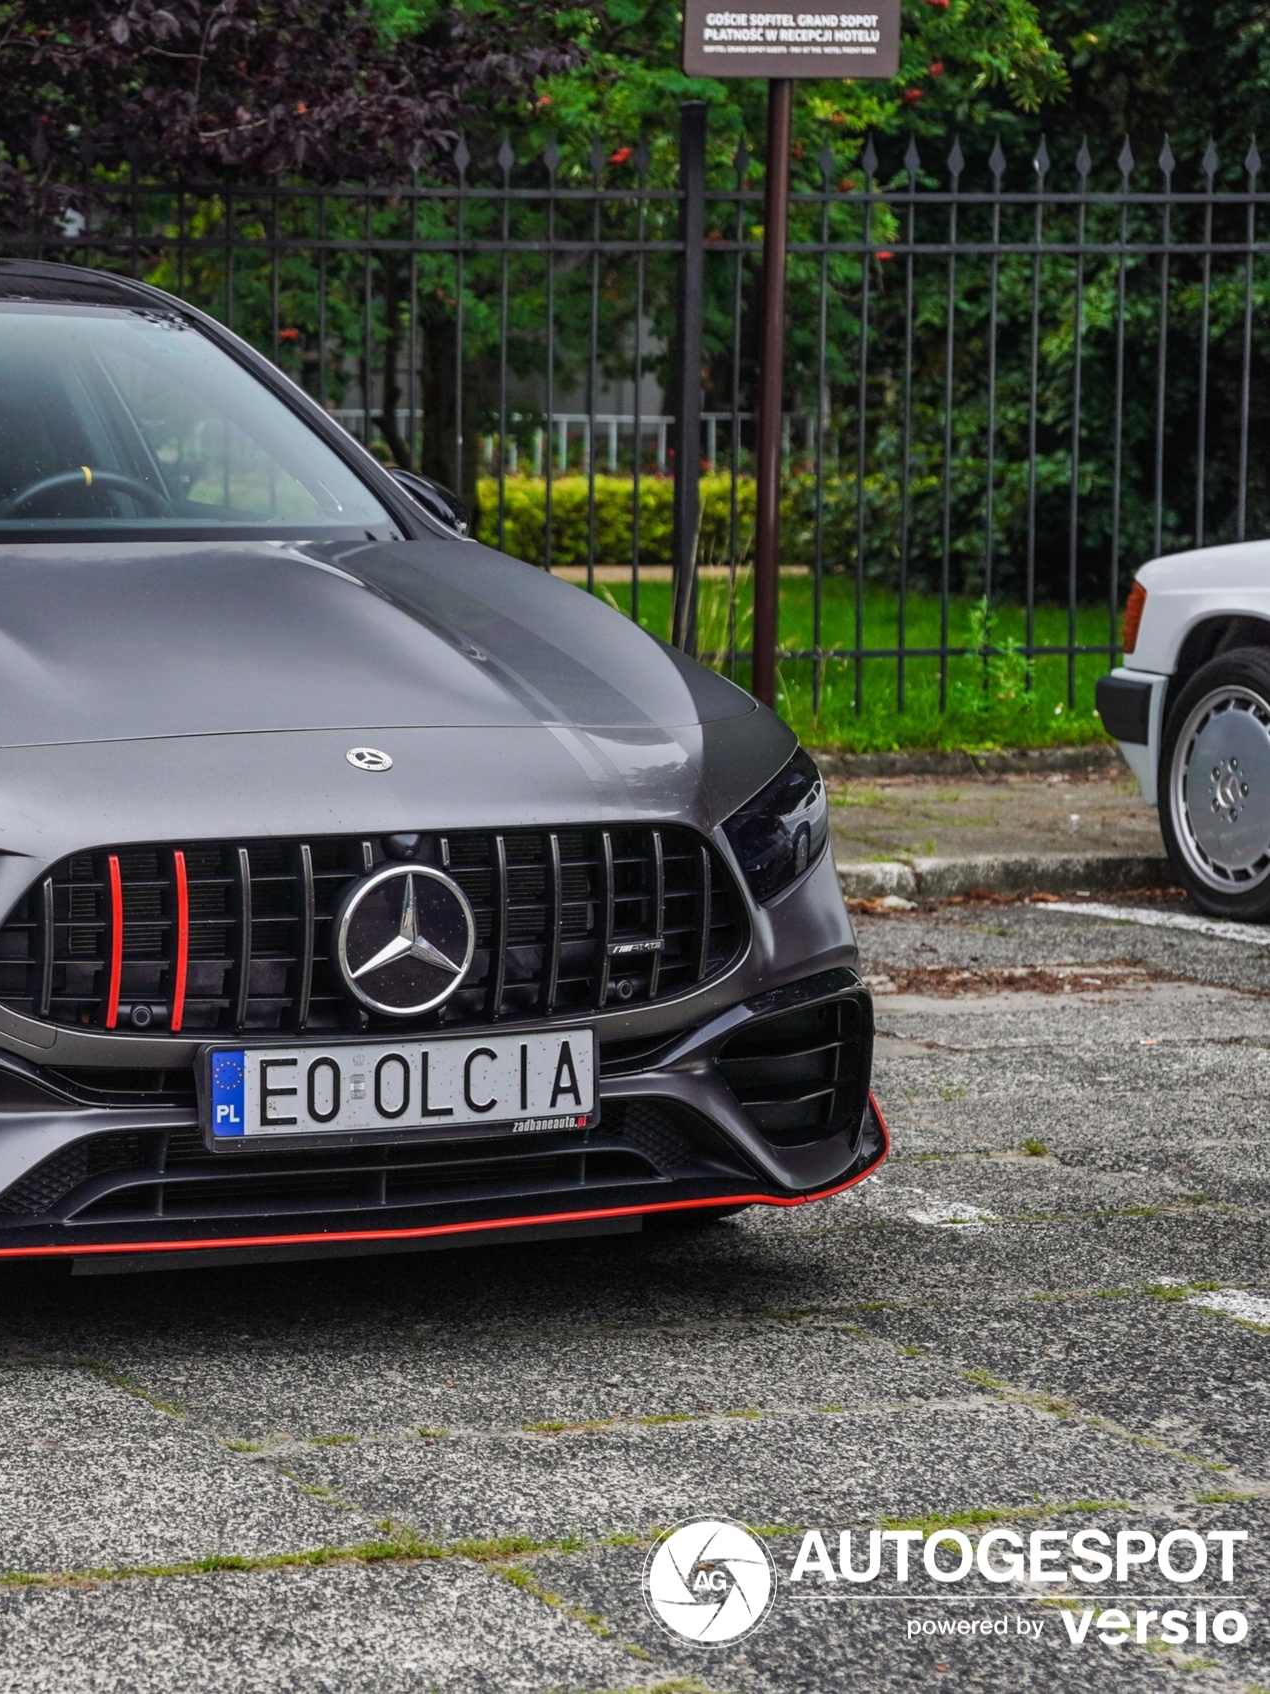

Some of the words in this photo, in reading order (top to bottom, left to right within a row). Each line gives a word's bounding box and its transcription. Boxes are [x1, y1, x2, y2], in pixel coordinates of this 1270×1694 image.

[706, 11, 748, 26] GOŚCIE
[749, 13, 796, 27] SOFITEL
[797, 14, 839, 27] GRAND
[840, 14, 879, 27] SOPOT
[703, 27, 764, 41] PŁATNOŚĆ
[765, 28, 778, 41] W
[779, 28, 833, 42] RECEPCJI
[834, 29, 880, 43] HOTELU
[374, 1040, 582, 1119] OLCIA
[216, 1104, 240, 1123] PL
[512, 1115, 587, 1132] zadbaneauto.pl
